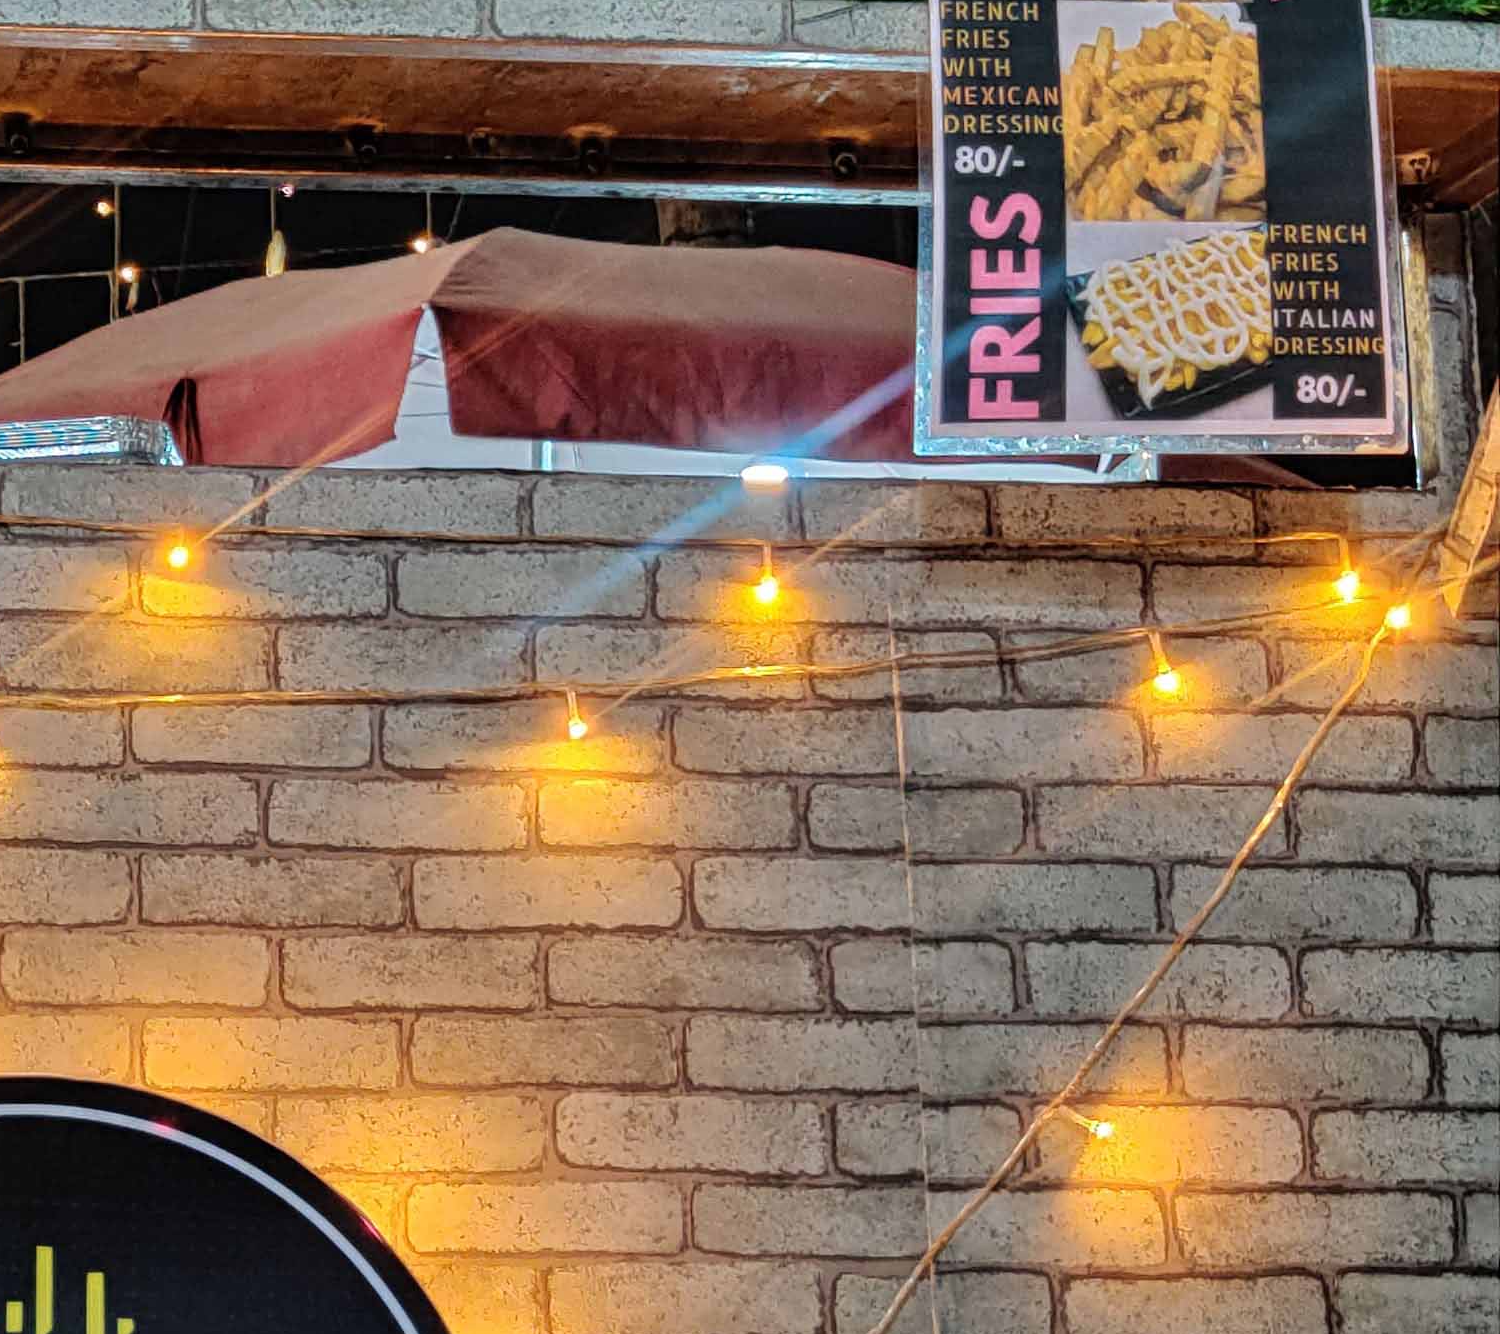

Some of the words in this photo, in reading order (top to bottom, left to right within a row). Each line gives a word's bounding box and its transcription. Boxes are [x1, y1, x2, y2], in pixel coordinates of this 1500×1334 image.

[940, 0, 1040, 22] FRENCH
[942, 28, 1011, 50] FRIES
[942, 56, 1012, 78] WITH
[943, 85, 1060, 106] MEXICAN
[943, 114, 1066, 135] DRESSING
[954, 144, 1026, 178] 80/-
[1270, 223, 1368, 244] FRENCH
[1271, 252, 1340, 273] FRIES
[1272, 280, 1341, 301] WITH
[968, 192, 1043, 420] FRIES
[1273, 308, 1376, 329] ITALIAN
[1274, 336, 1385, 356] DRESSING
[1296, 373, 1368, 408] 80/-
